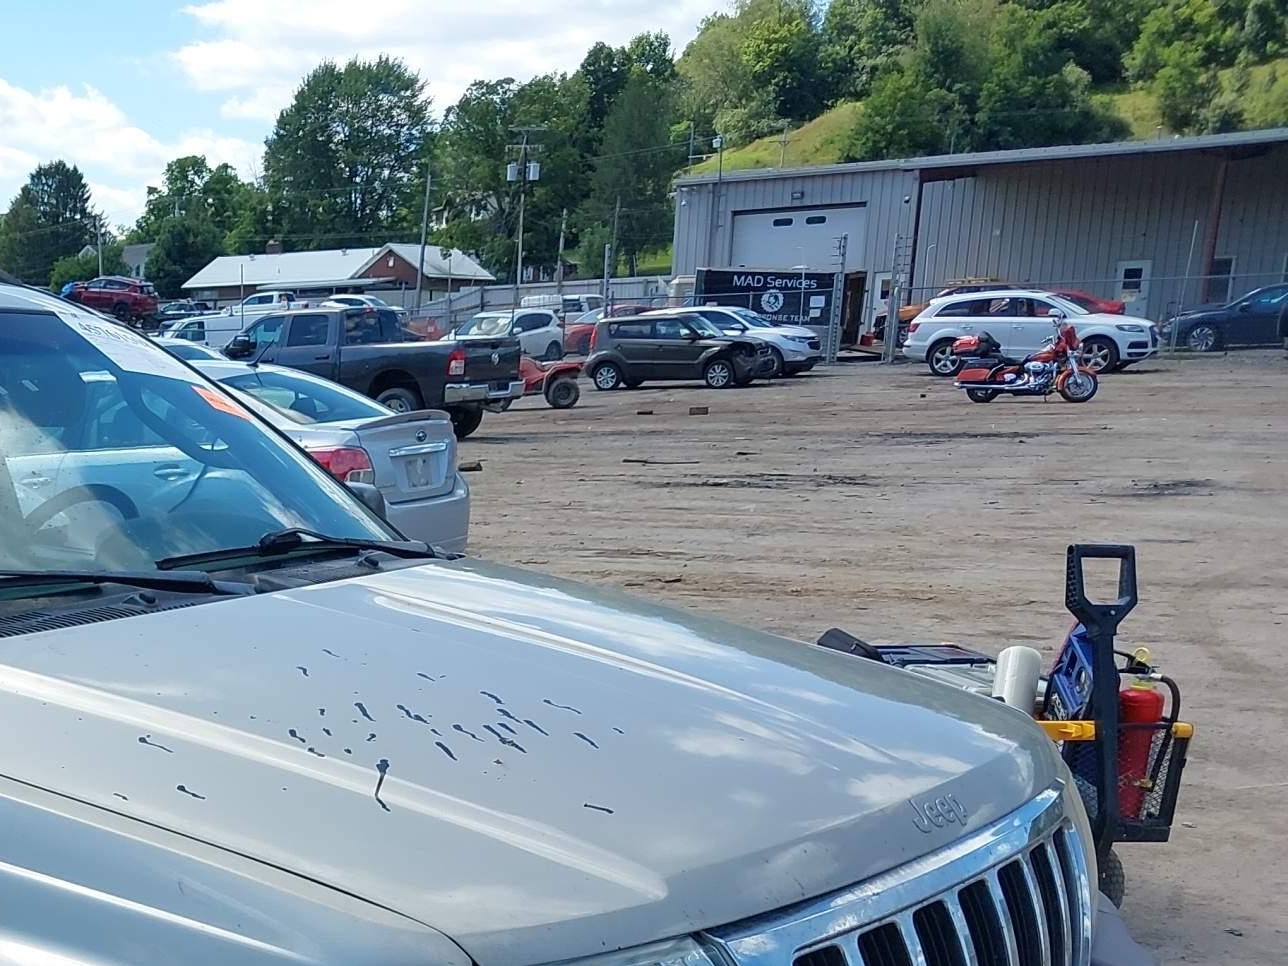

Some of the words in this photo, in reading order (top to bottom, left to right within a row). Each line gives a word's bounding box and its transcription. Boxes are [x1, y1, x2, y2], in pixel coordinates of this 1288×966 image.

[733, 275, 764, 287] MAD
[767, 276, 817, 288] Services
[907, 793, 968, 833] Jeep
